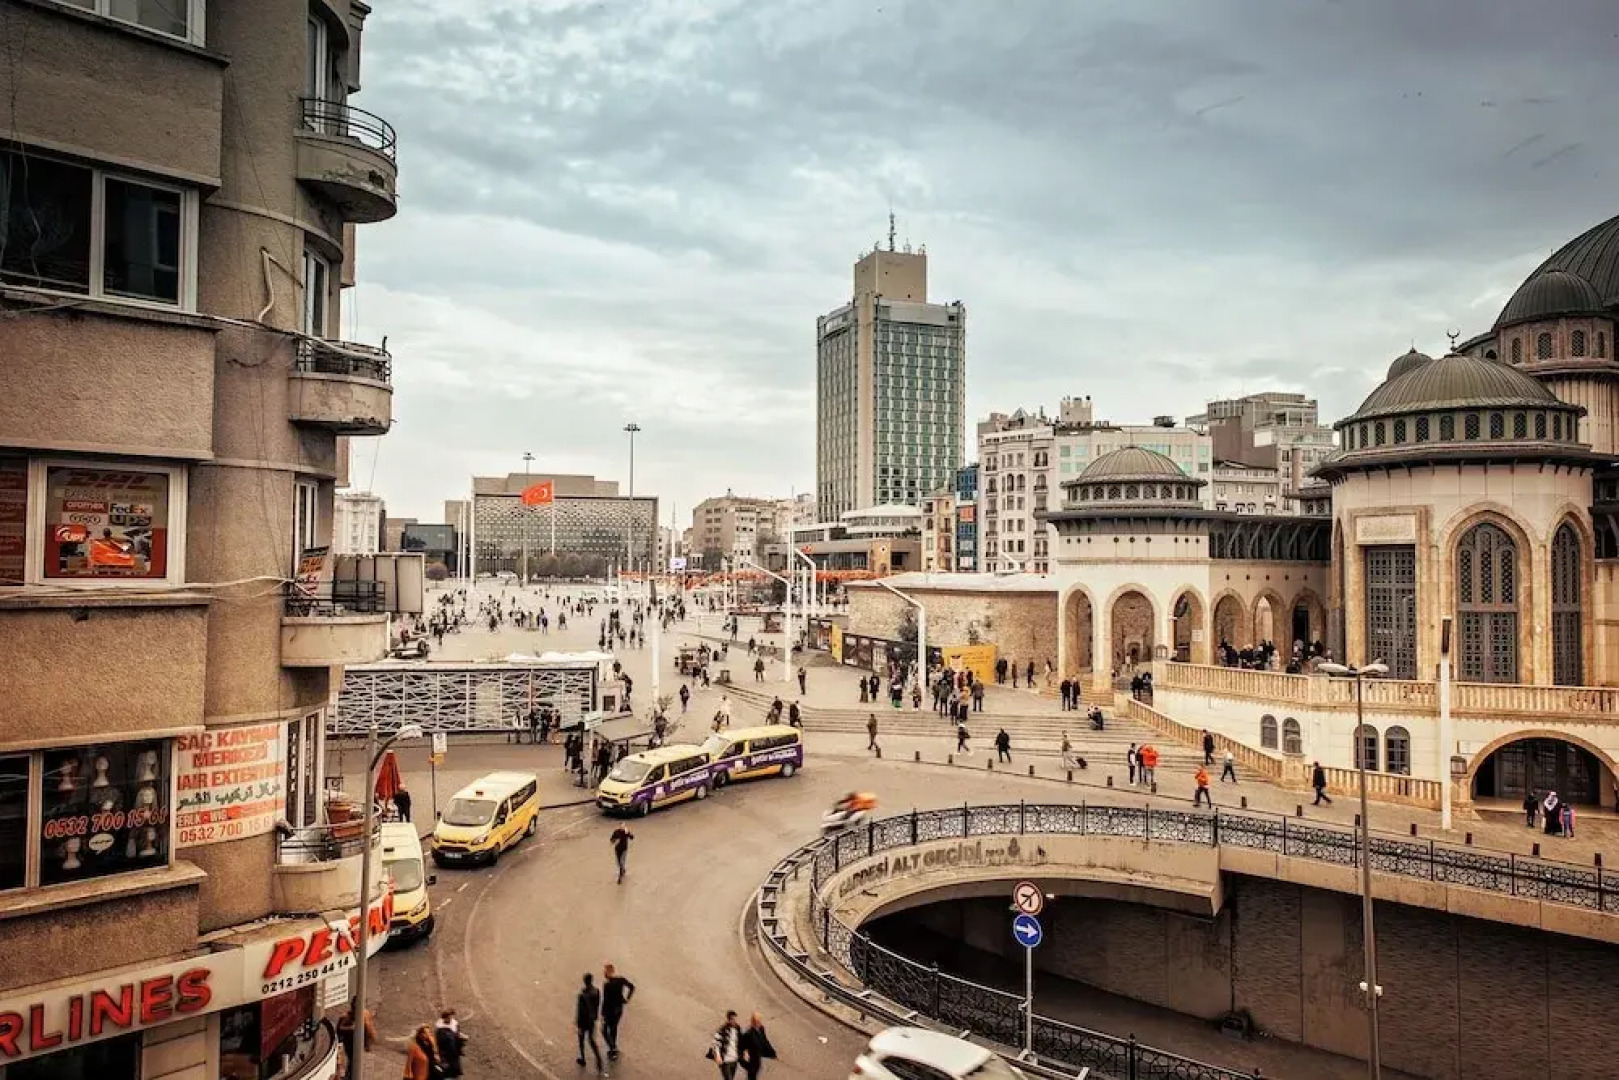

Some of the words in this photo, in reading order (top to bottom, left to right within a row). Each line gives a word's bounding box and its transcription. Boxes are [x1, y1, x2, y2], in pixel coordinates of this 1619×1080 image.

[110, 503, 150, 514] FedEx
[177, 733, 212, 752] SAÇ
[44, 815, 89, 839] 0532
[92, 810, 125, 833] 700
[181, 827, 214, 843] 0532
[220, 822, 243, 838] 700
[892, 853, 921, 876] ALT
[261, 978, 294, 995] 0212
[297, 968, 319, 985] 250
[321, 962, 335, 975] 44
